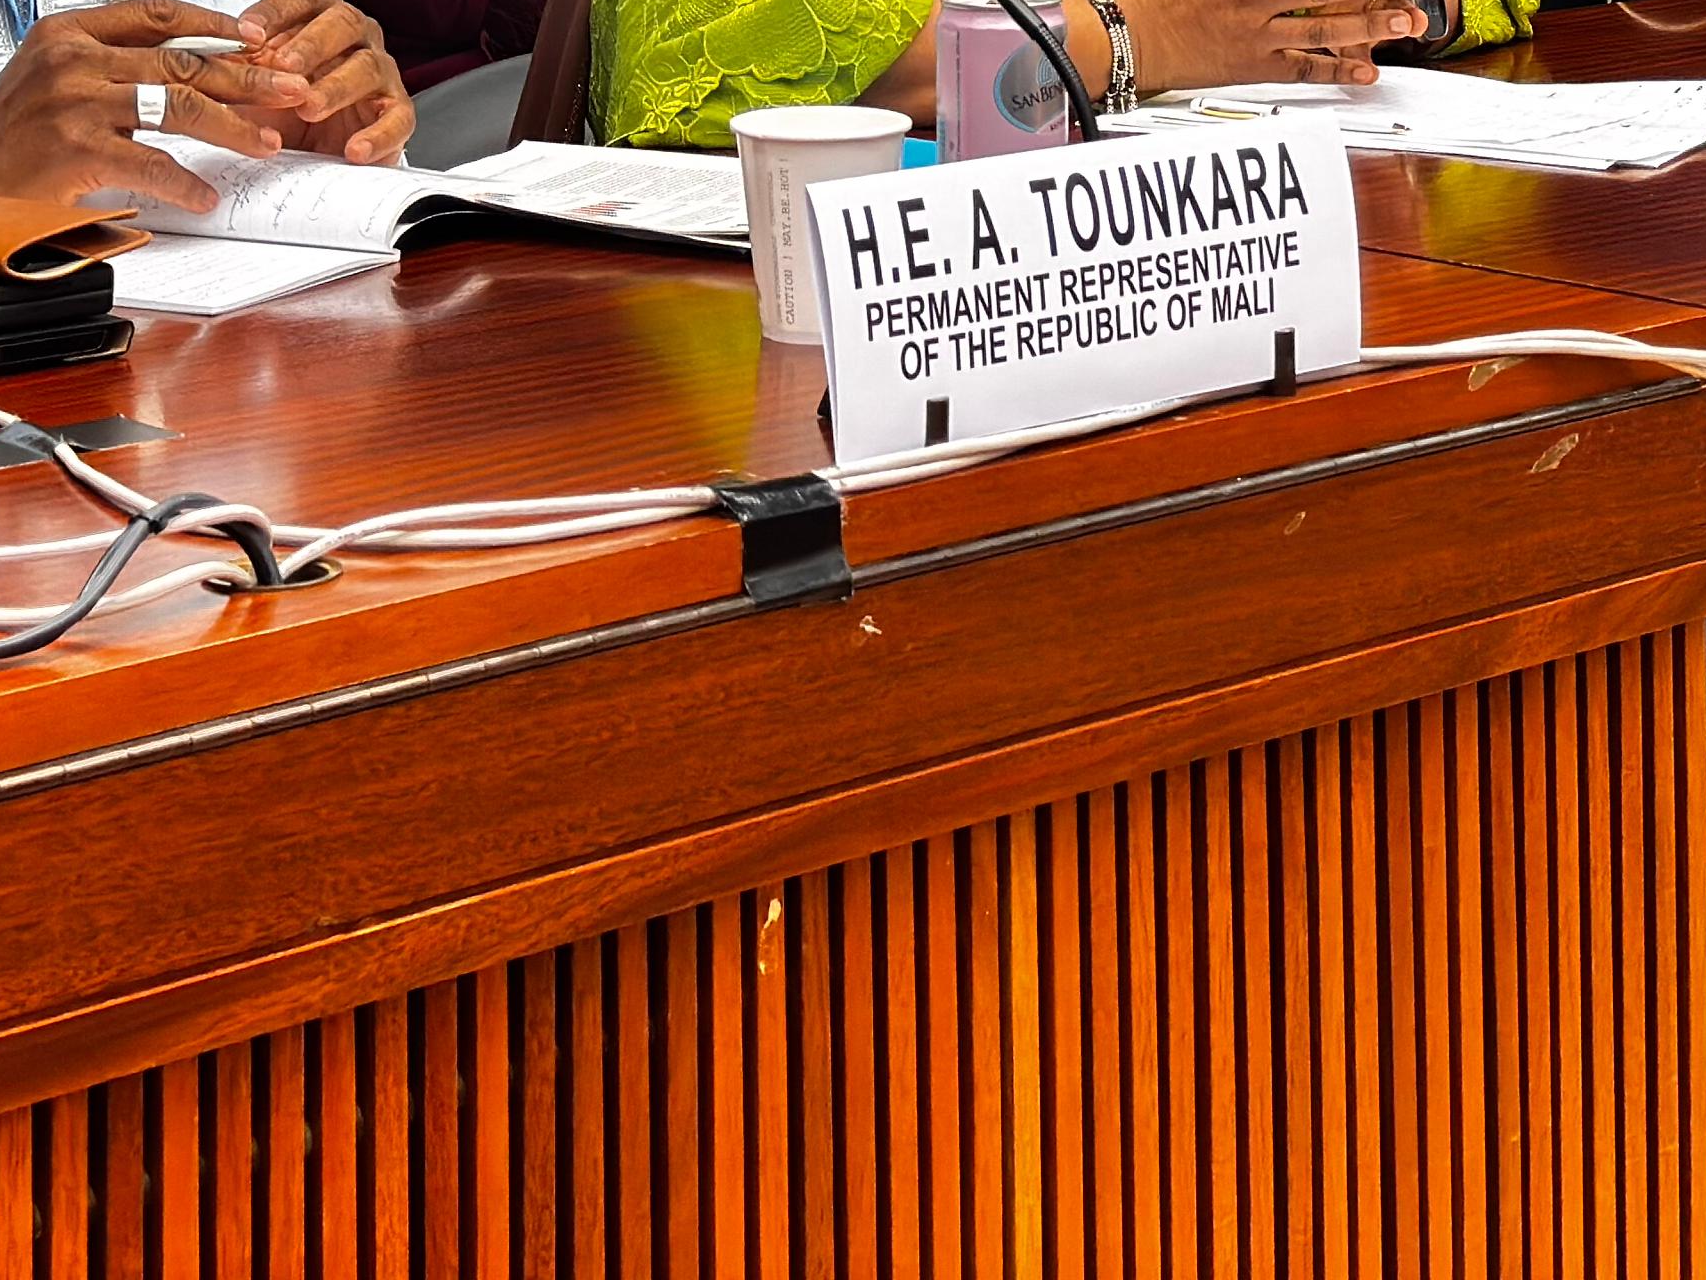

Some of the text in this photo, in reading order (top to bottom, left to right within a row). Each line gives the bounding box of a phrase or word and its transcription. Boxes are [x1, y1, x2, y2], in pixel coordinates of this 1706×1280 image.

[842, 197, 951, 290] H.E.
[972, 189, 1019, 270] A.
[1029, 142, 1309, 257] TOUNKARA
[866, 231, 1300, 342] PERMANENT REPRESENTATIVE
[900, 277, 1275, 380] OF THE REPUBLIC OF MALI
